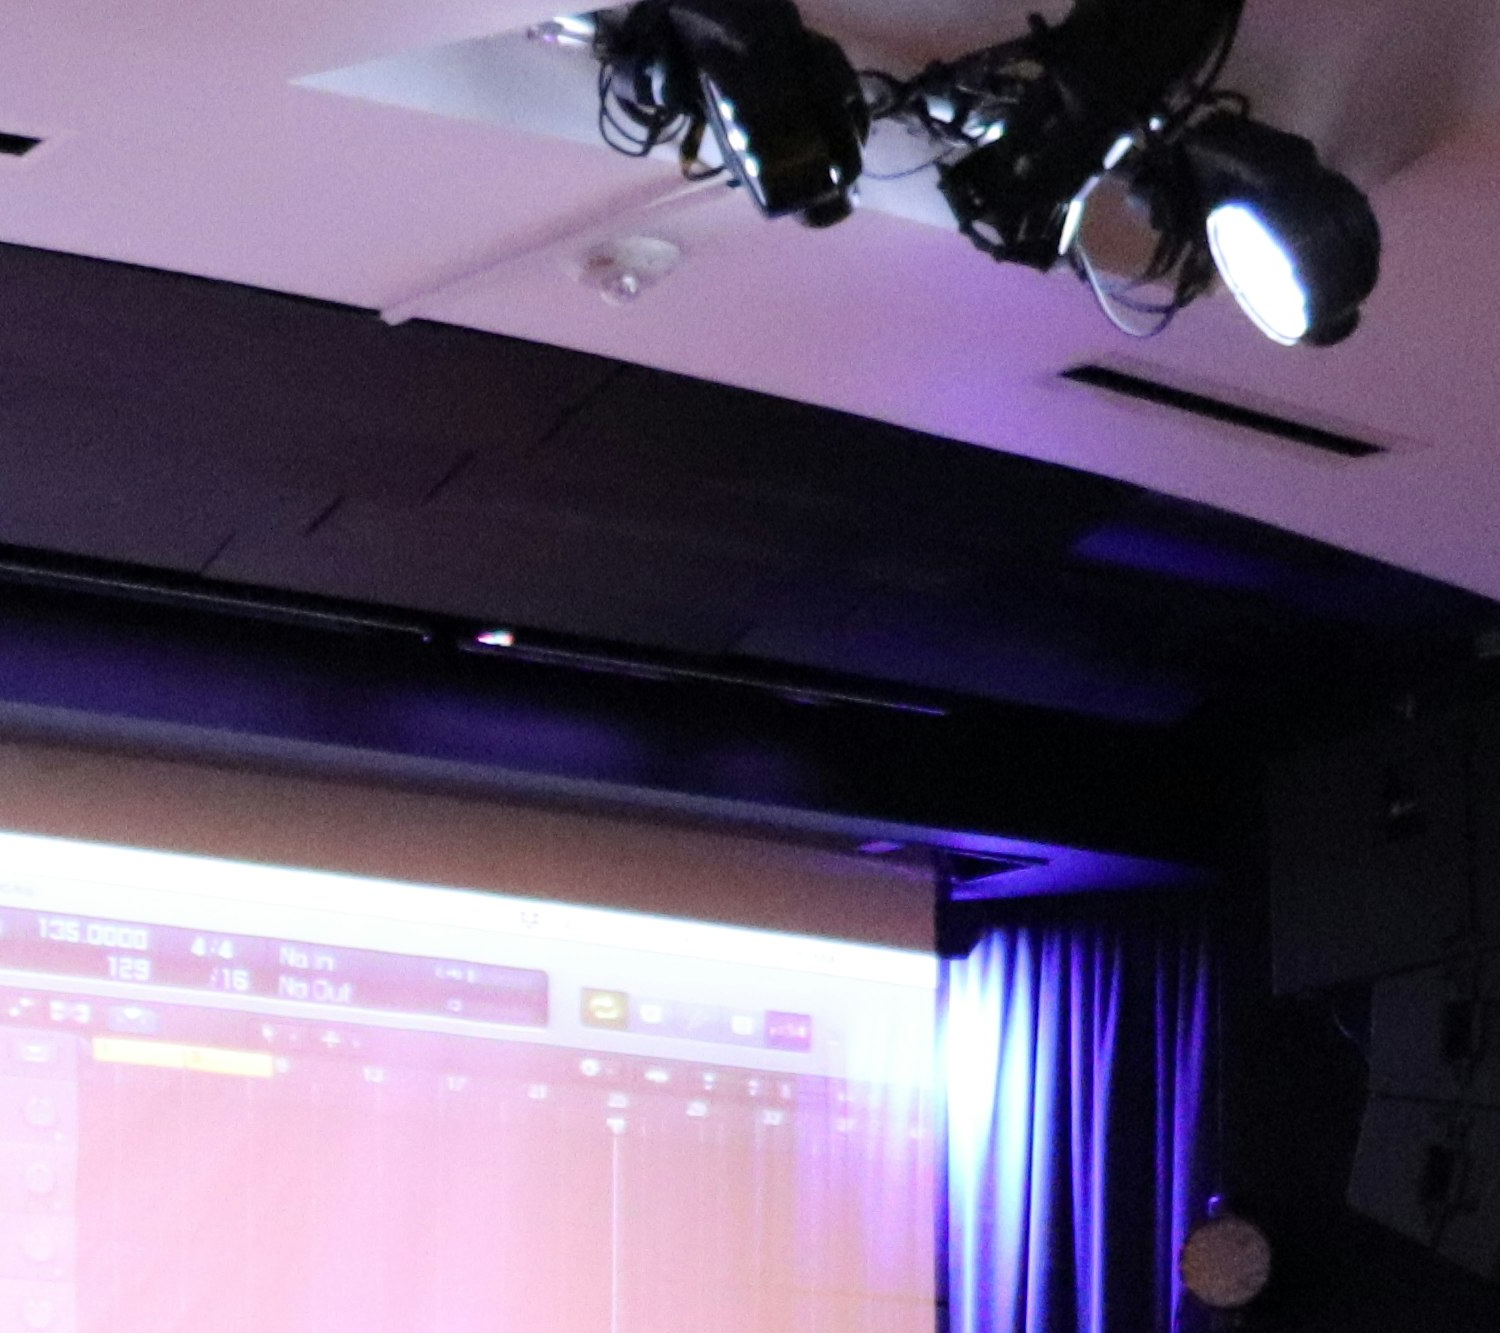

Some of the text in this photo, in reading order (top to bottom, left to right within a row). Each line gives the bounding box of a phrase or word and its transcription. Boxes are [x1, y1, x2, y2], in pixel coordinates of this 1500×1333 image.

[37, 917, 150, 951] 135.0000
[107, 956, 151, 981] 129
[279, 946, 308, 970] No
[279, 976, 353, 1002] No Out
